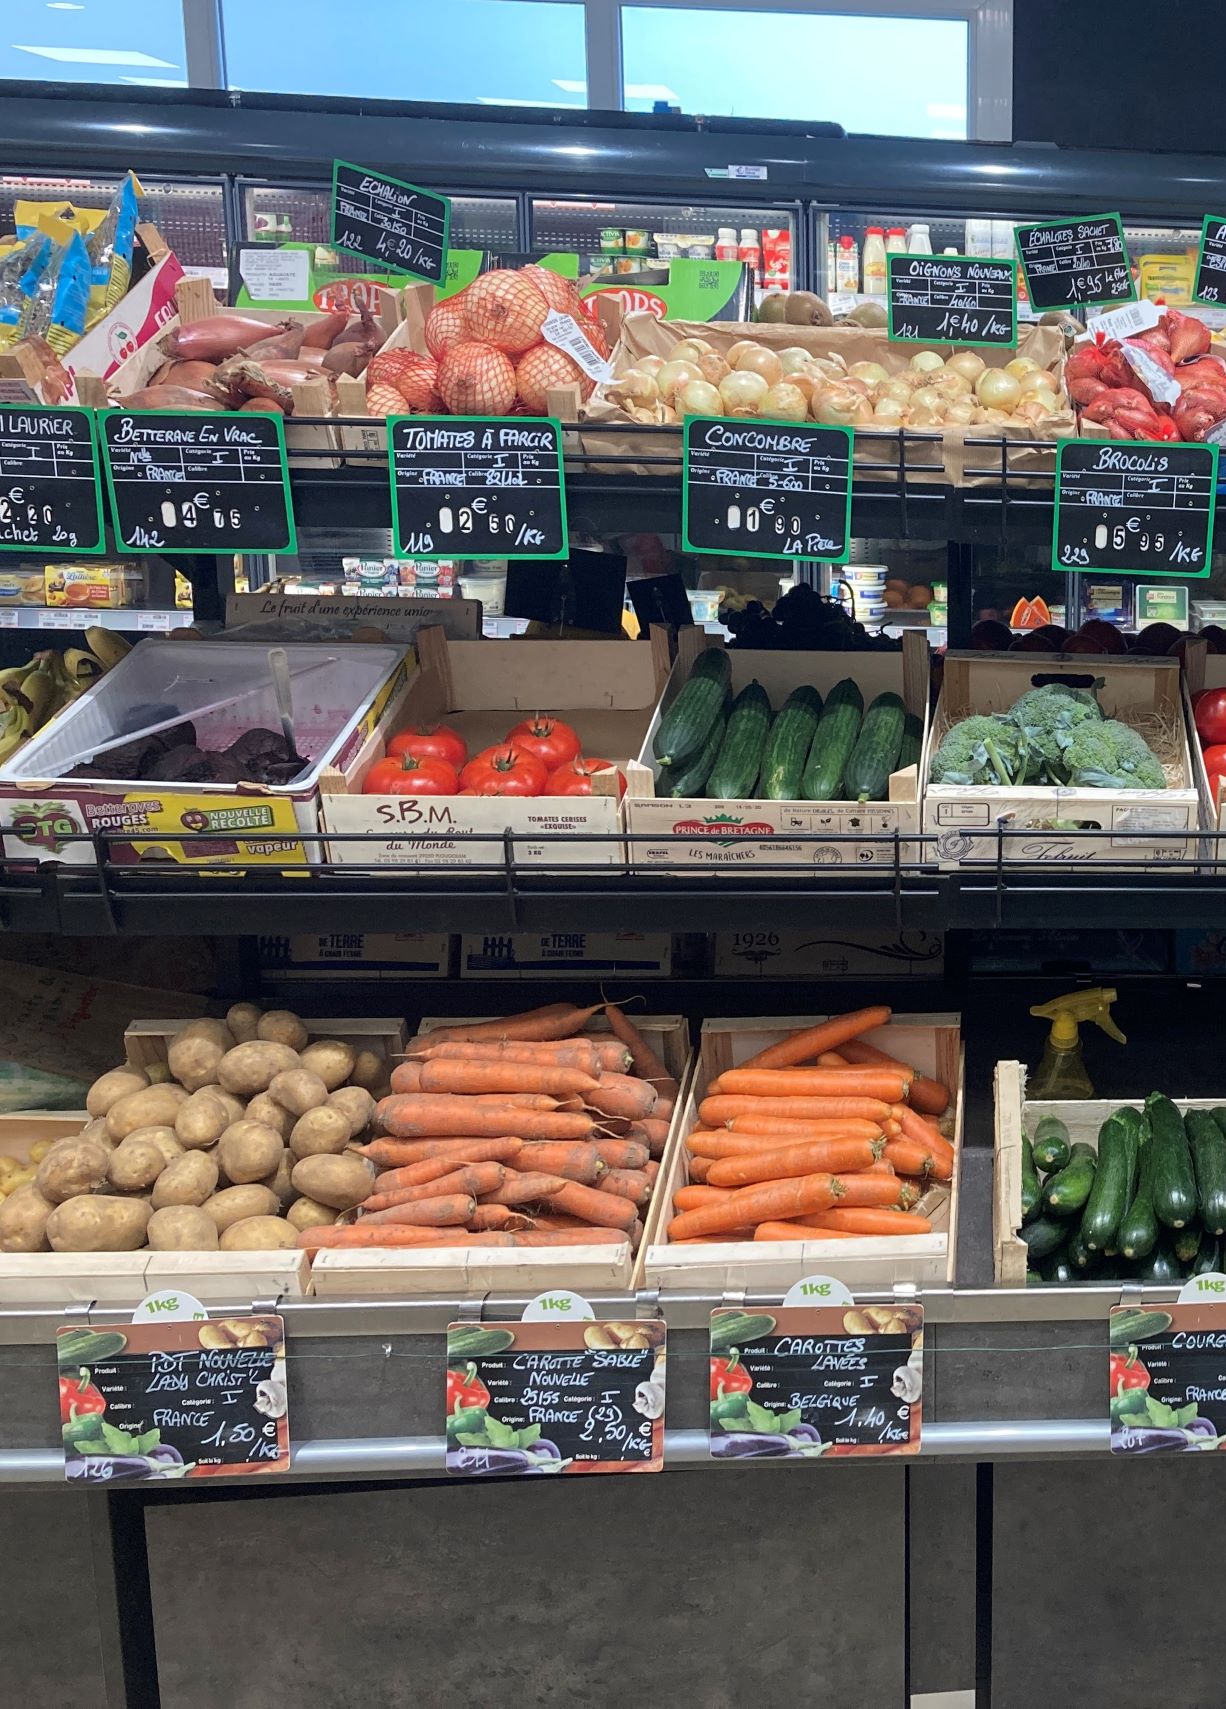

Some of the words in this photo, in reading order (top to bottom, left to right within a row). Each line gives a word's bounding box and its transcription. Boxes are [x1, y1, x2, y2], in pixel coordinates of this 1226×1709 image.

[1078, 224, 1109, 238] SACHET
[336, 231, 363, 250] 122
[1199, 285, 1218, 301] 123
[895, 323, 918, 338] 121
[114, 418, 195, 442] BETTERAVE
[224, 426, 262, 443] VRAC
[403, 428, 475, 449] TOMATES
[705, 425, 817, 452] CONCOMBRE
[423, 469, 466, 485] FRANCE
[127, 526, 165, 547] 142
[783, 538, 803, 553] LA
[1061, 545, 1089, 564] 229
[278, 601, 305, 617] fruit
[85, 801, 160, 817] Betteraves
[210, 807, 267, 820] NOUVELLE
[376, 800, 456, 823] S.B.M.
[92, 814, 147, 828] ROUGES
[676, 826, 709, 834] PRINCE
[247, 842, 299, 855] vapeur
[409, 841, 456, 850] Monde
[689, 849, 702, 859] LES
[706, 850, 755, 861] MARAÎCHERS
[330, 935, 364, 948] TERRE
[552, 935, 586, 948] TERRE
[732, 931, 780, 947] 1926
[800, 1283, 831, 1296] 1kg
[1196, 1280, 1225, 1292] 1kg
[146, 1297, 179, 1313] 1kg
[539, 1298, 572, 1311] 1kg
[774, 1337, 866, 1356] CAROTTES
[148, 1351, 198, 1373] PDT
[199, 1350, 278, 1368] NOUVELLE
[512, 1354, 585, 1370] CAROTTE
[145, 1373, 189, 1393] LADY
[529, 1371, 595, 1386] NOUVELLE
[153, 1409, 214, 1427] FRANCE
[528, 1407, 584, 1423] FRANCE
